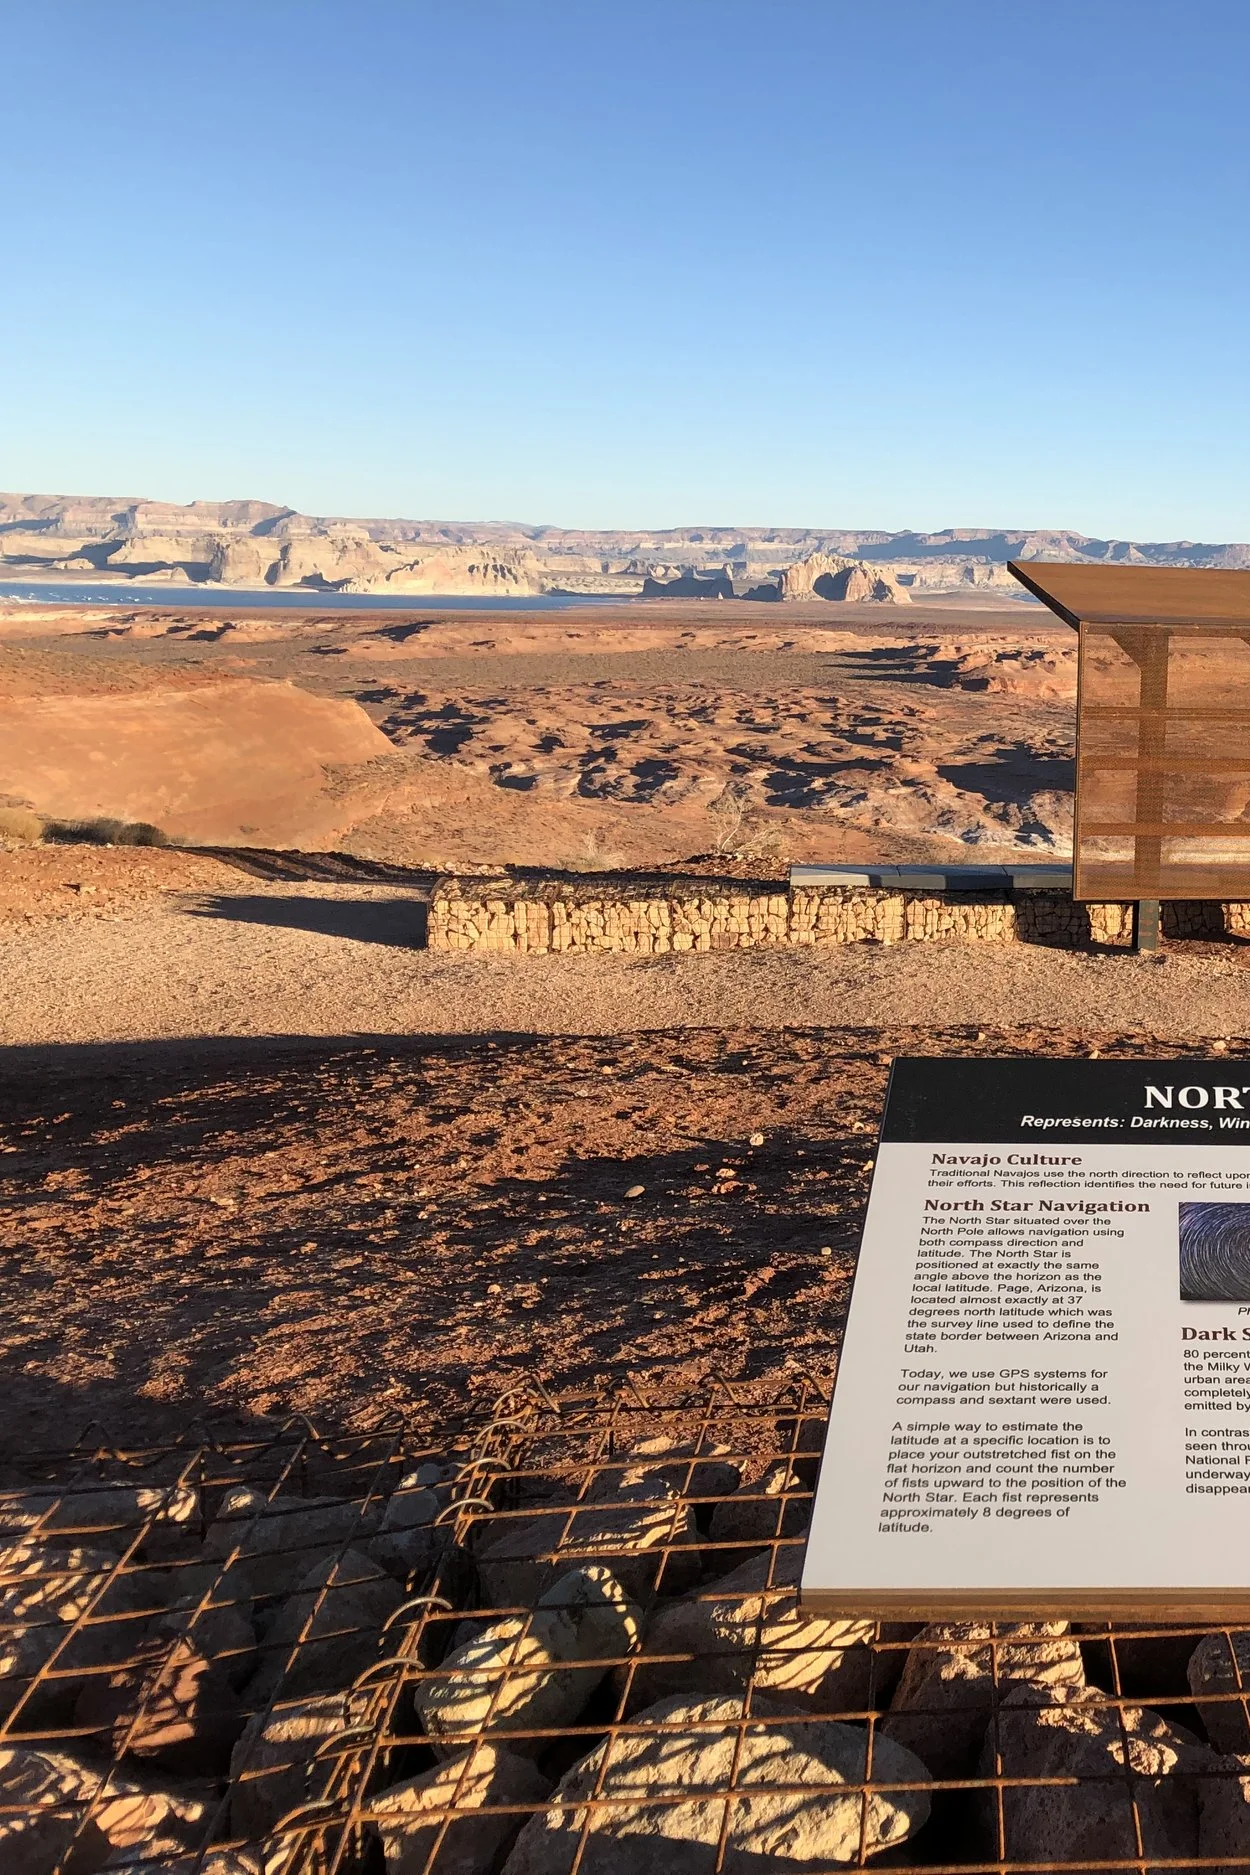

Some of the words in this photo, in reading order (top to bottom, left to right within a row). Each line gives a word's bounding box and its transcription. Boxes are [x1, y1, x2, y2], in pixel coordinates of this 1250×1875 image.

[1020, 1114, 1125, 1130] Represents:
[1130, 1115, 1213, 1130] Darkness,
[931, 1153, 1001, 1168] Navajo
[1006, 1153, 1082, 1165] Culture
[927, 1179, 953, 1187] their
[956, 1179, 996, 1187] efforts.
[1000, 1179, 1025, 1187] This
[1027, 1179, 1081, 1188] reflection
[1084, 1180, 1135, 1188] identifies
[1138, 1180, 1156, 1188] the
[1159, 1180, 1188, 1189] need
[1191, 1180, 1207, 1189] for
[1209, 1180, 1243, 1189] future
[923, 1198, 984, 1211] North
[989, 1199, 1034, 1211] Star
[1038, 1199, 1150, 1215] Navigation
[920, 1226, 954, 1235] North
[956, 1226, 984, 1236] Pole
[987, 1227, 1025, 1236] allows
[1028, 1227, 1089, 1238] navigation
[1092, 1227, 1124, 1238] using
[911, 1283, 941, 1292] local
[944, 1283, 992, 1292] latitude.
[997, 1283, 1033, 1294] Page,
[1036, 1283, 1087, 1293] Arizona,
[1091, 1283, 1101, 1293] is
[910, 1295, 956, 1304] located
[959, 1295, 1001, 1304] almost
[1004, 1295, 1048, 1306] exactly
[1051, 1295, 1064, 1304] at
[1067, 1295, 1083, 1304] 37
[1181, 1326, 1237, 1341] Dark
[903, 1343, 938, 1353] Utah.
[1183, 1348, 1199, 1358] 80
[1203, 1349, 1250, 1360] percent
[900, 1368, 944, 1381] Today,
[948, 1370, 967, 1378] we
[971, 1370, 995, 1378] use
[999, 1368, 1030, 1379] GPS
[1033, 1369, 1087, 1381] systems
[1090, 1368, 1108, 1378] for
[895, 1396, 956, 1407] compass
[959, 1394, 984, 1405] and
[988, 1395, 1036, 1405] sextant
[1039, 1396, 1072, 1405] were
[1075, 1395, 1111, 1405] used.
[1184, 1400, 1232, 1410] emitted
[1185, 1427, 1197, 1437] In
[1185, 1454, 1240, 1465] National
[882, 1492, 920, 1502] North
[925, 1492, 958, 1502] Star.
[962, 1491, 998, 1502] Each
[1001, 1491, 1022, 1502] fist
[1026, 1492, 1099, 1504] represents
[880, 1506, 979, 1520] approximately
[982, 1506, 991, 1517] 8
[995, 1506, 1052, 1519] degrees
[1055, 1506, 1070, 1517] of
[878, 1521, 934, 1532] latitude.
